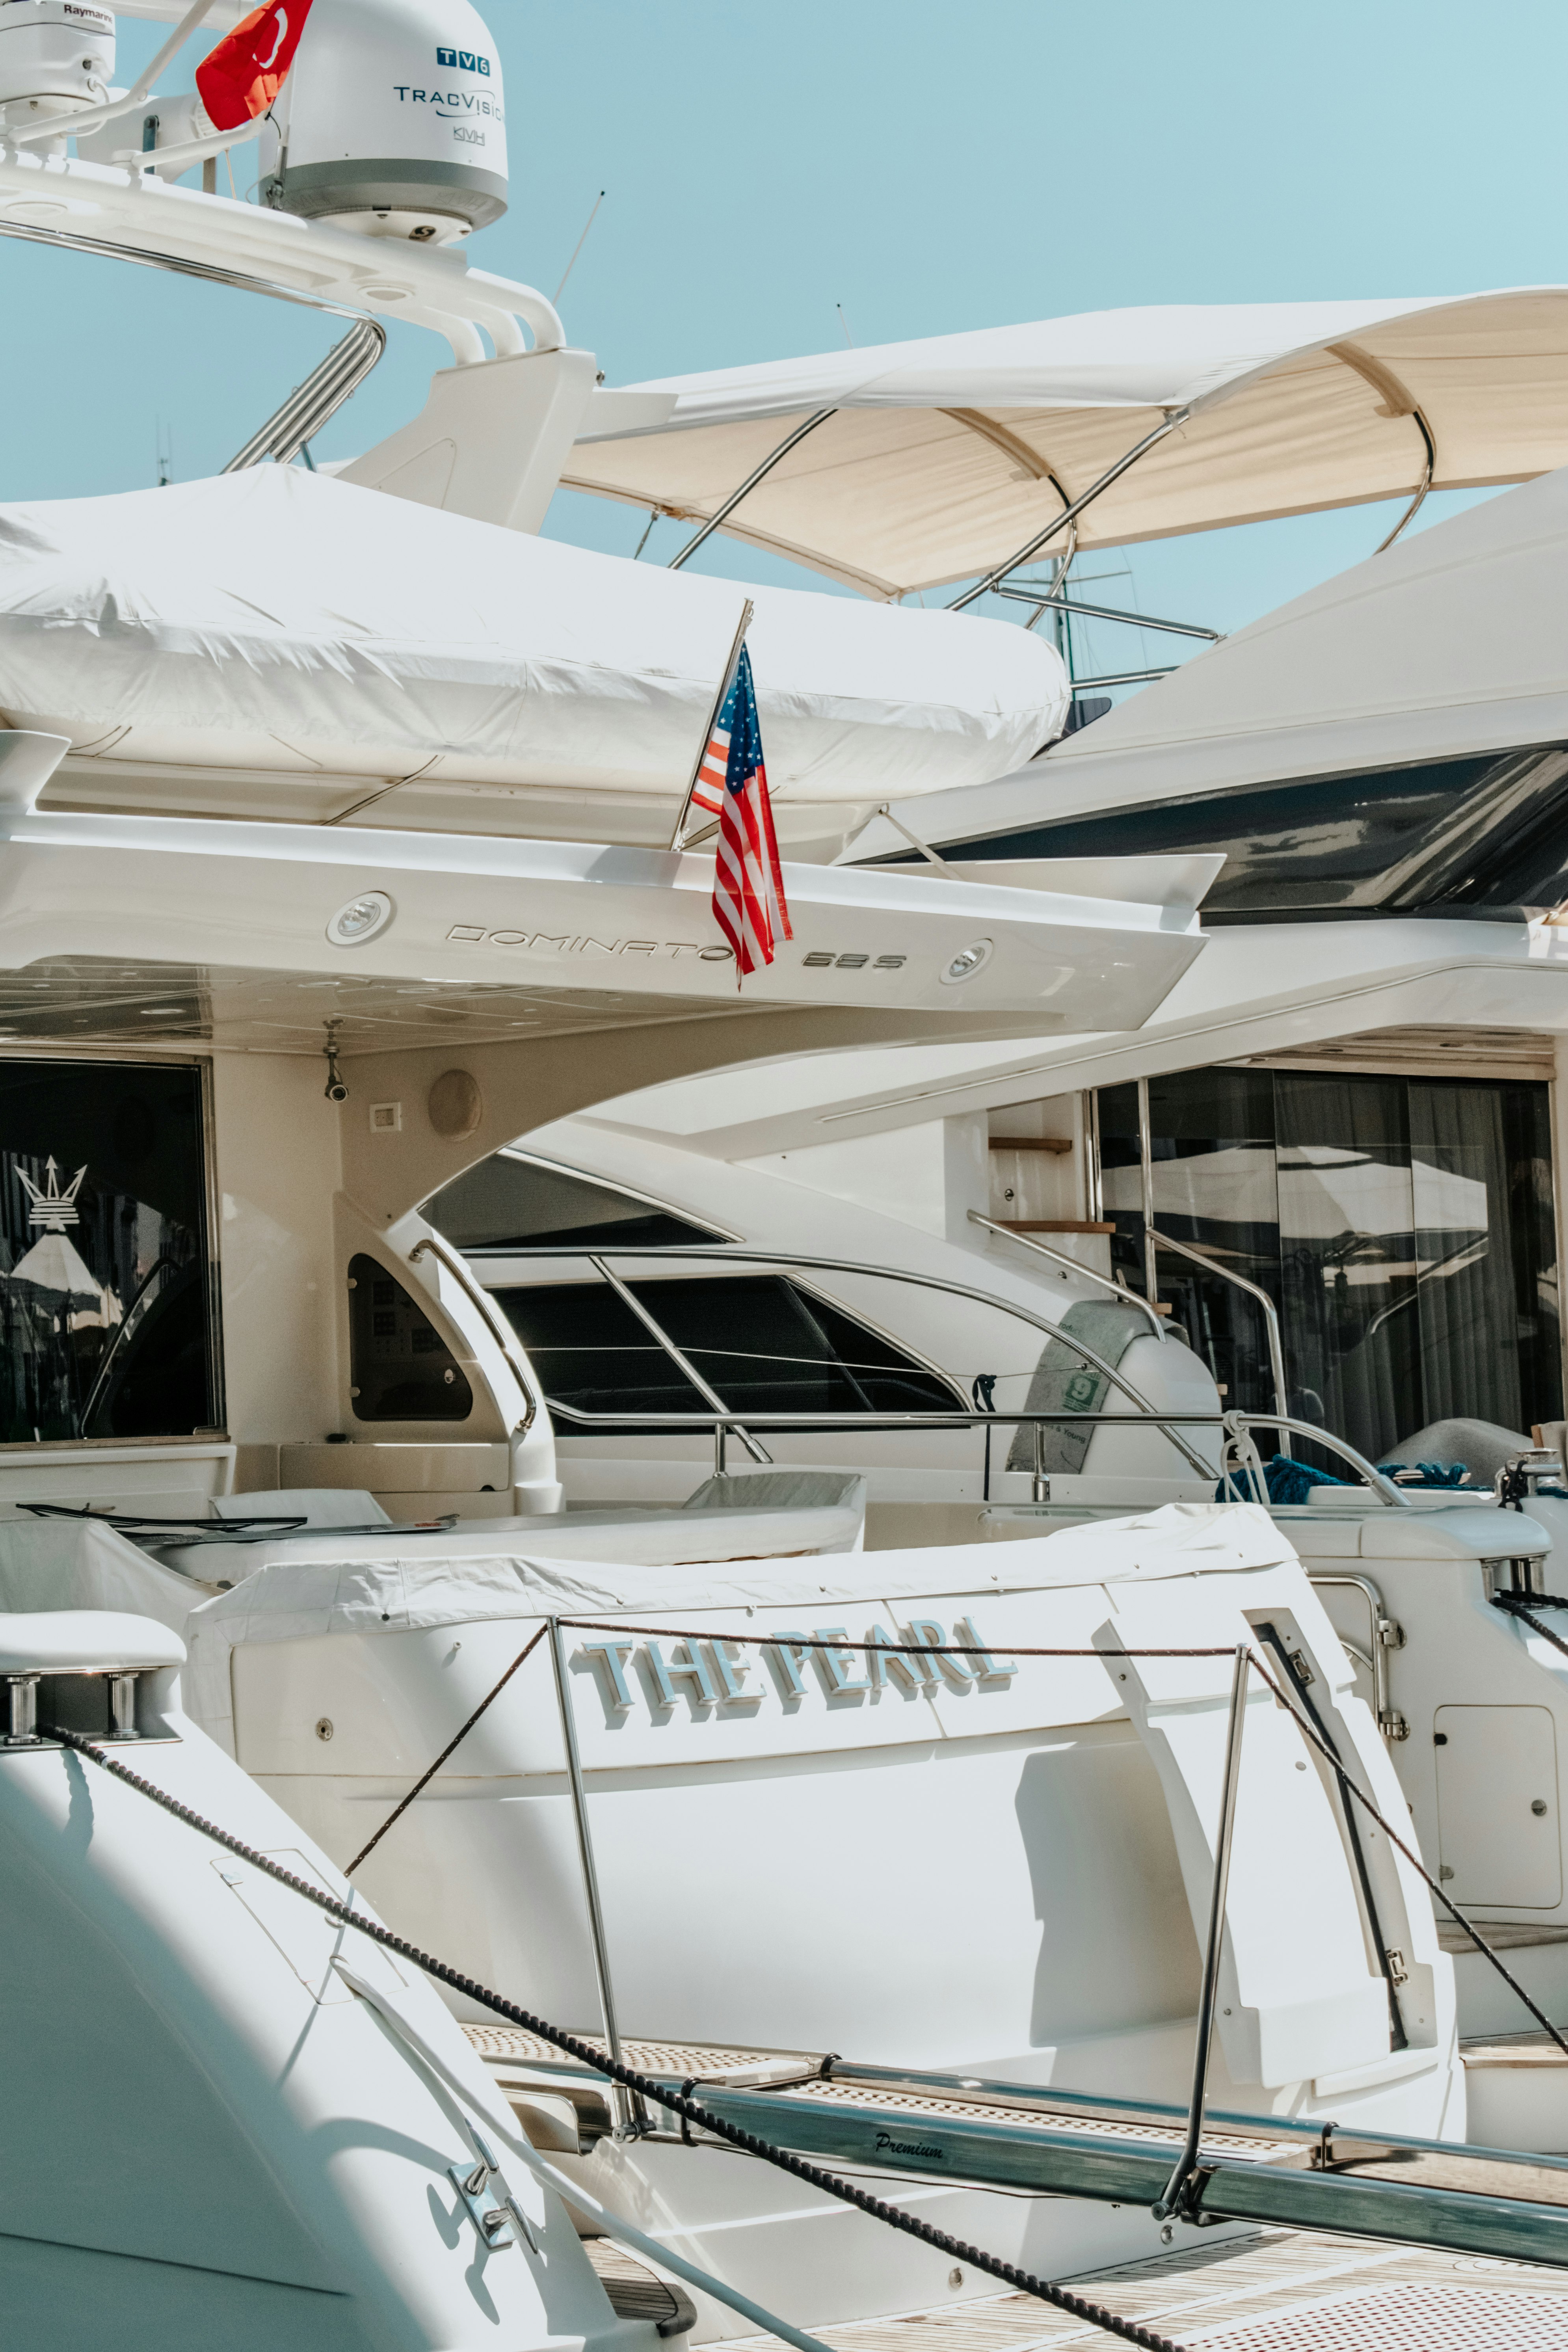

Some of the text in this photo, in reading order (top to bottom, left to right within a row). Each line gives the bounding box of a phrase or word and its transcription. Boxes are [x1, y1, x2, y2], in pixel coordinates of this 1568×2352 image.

[439, 49, 489, 75] TV6
[393, 87, 504, 123] TRACVISIO
[453, 126, 485, 147] KVH
[446, 925, 738, 962] DOMINATO
[1064, 1428, 1086, 1444] Young
[582, 1615, 1019, 1708] THE PEARL
[876, 2132, 943, 2158] Premium
